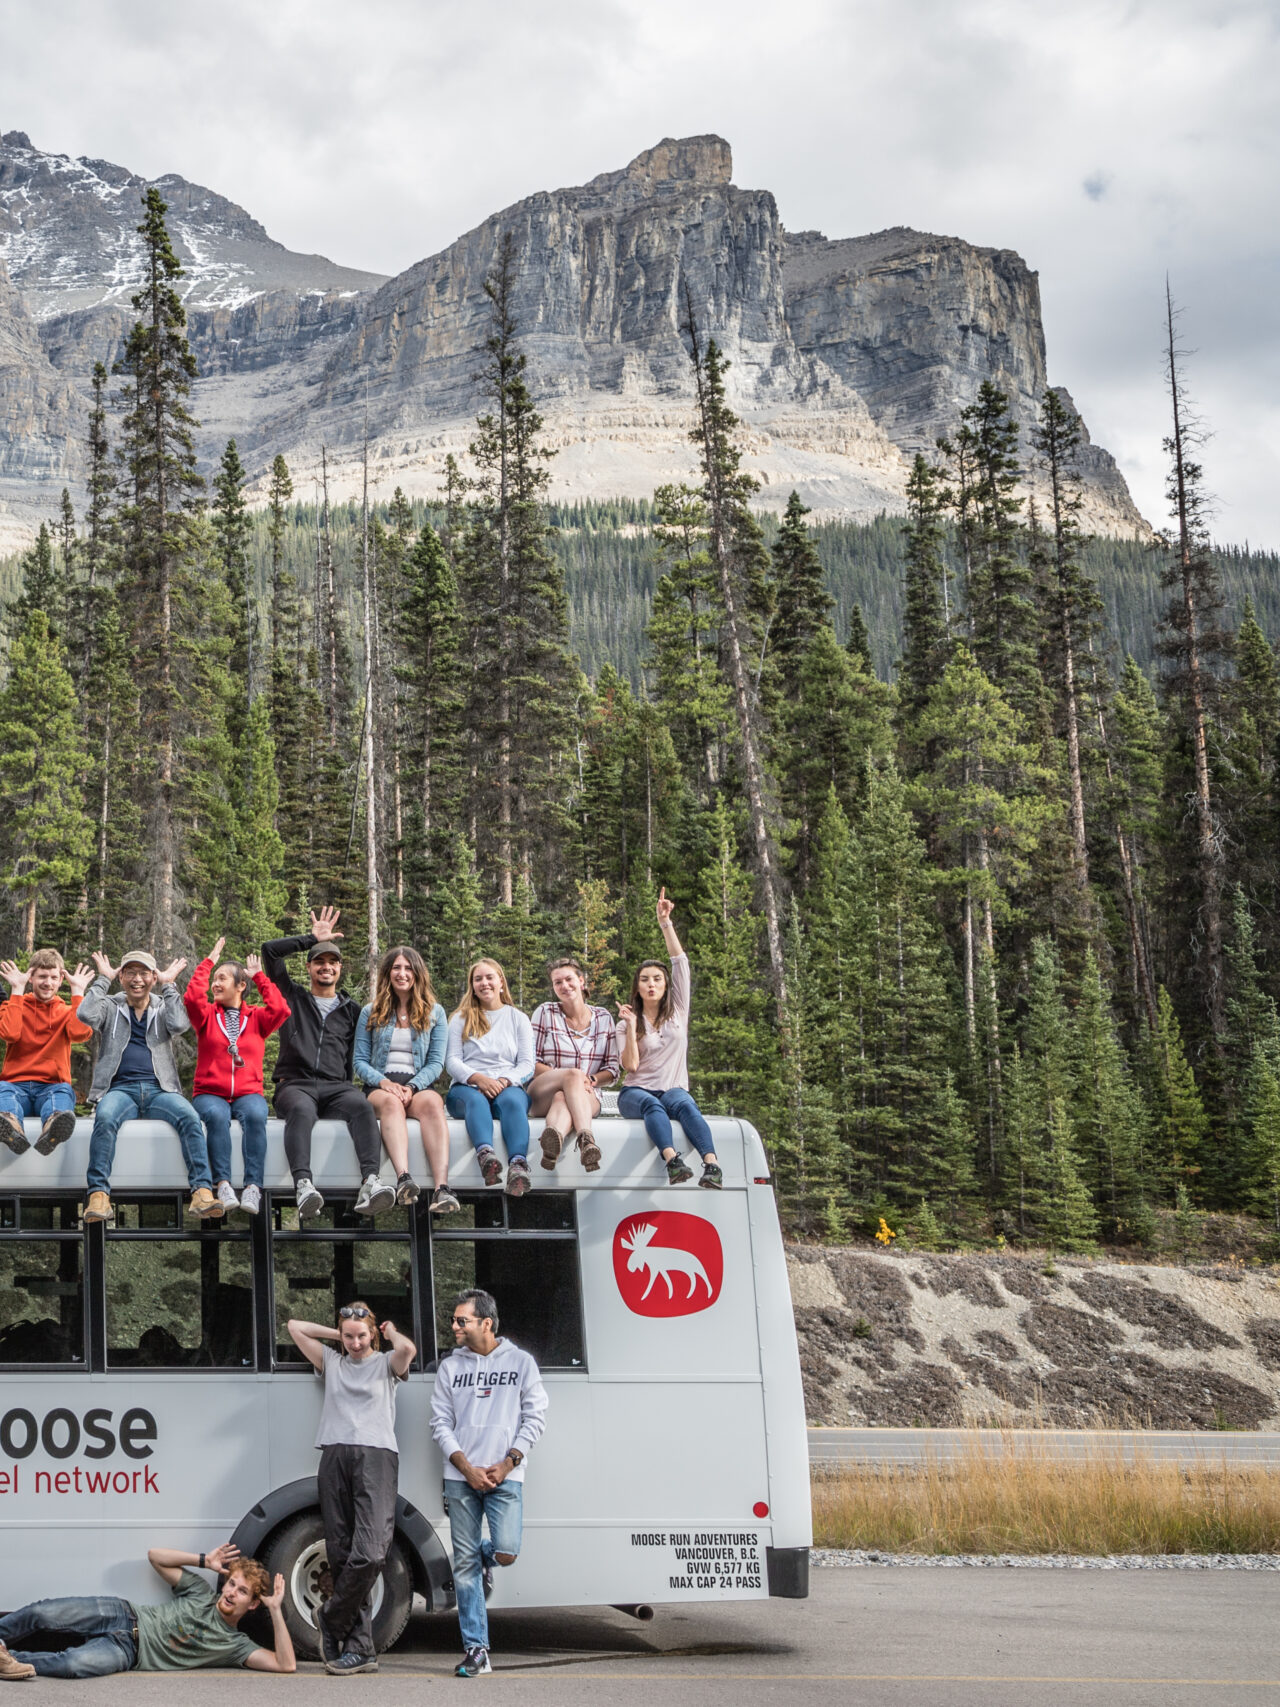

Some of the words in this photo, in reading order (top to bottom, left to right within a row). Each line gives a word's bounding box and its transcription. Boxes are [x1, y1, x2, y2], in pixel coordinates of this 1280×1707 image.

[452, 1371, 519, 1388] HILFIGER
[35, 1464, 160, 1494] network
[631, 1533, 666, 1546] MOOSE
[669, 1533, 691, 1546] RUN
[694, 1533, 758, 1546] ADVENTURES
[675, 1547, 738, 1561] VANCOUVER,
[740, 1547, 759, 1560] B.C.
[687, 1562, 711, 1574] GVW
[714, 1562, 742, 1576] 6,577
[746, 1562, 761, 1574] KG
[669, 1576, 694, 1589] MAX
[696, 1576, 717, 1589] CAP
[719, 1576, 733, 1589] 24
[735, 1576, 762, 1589] PASS
